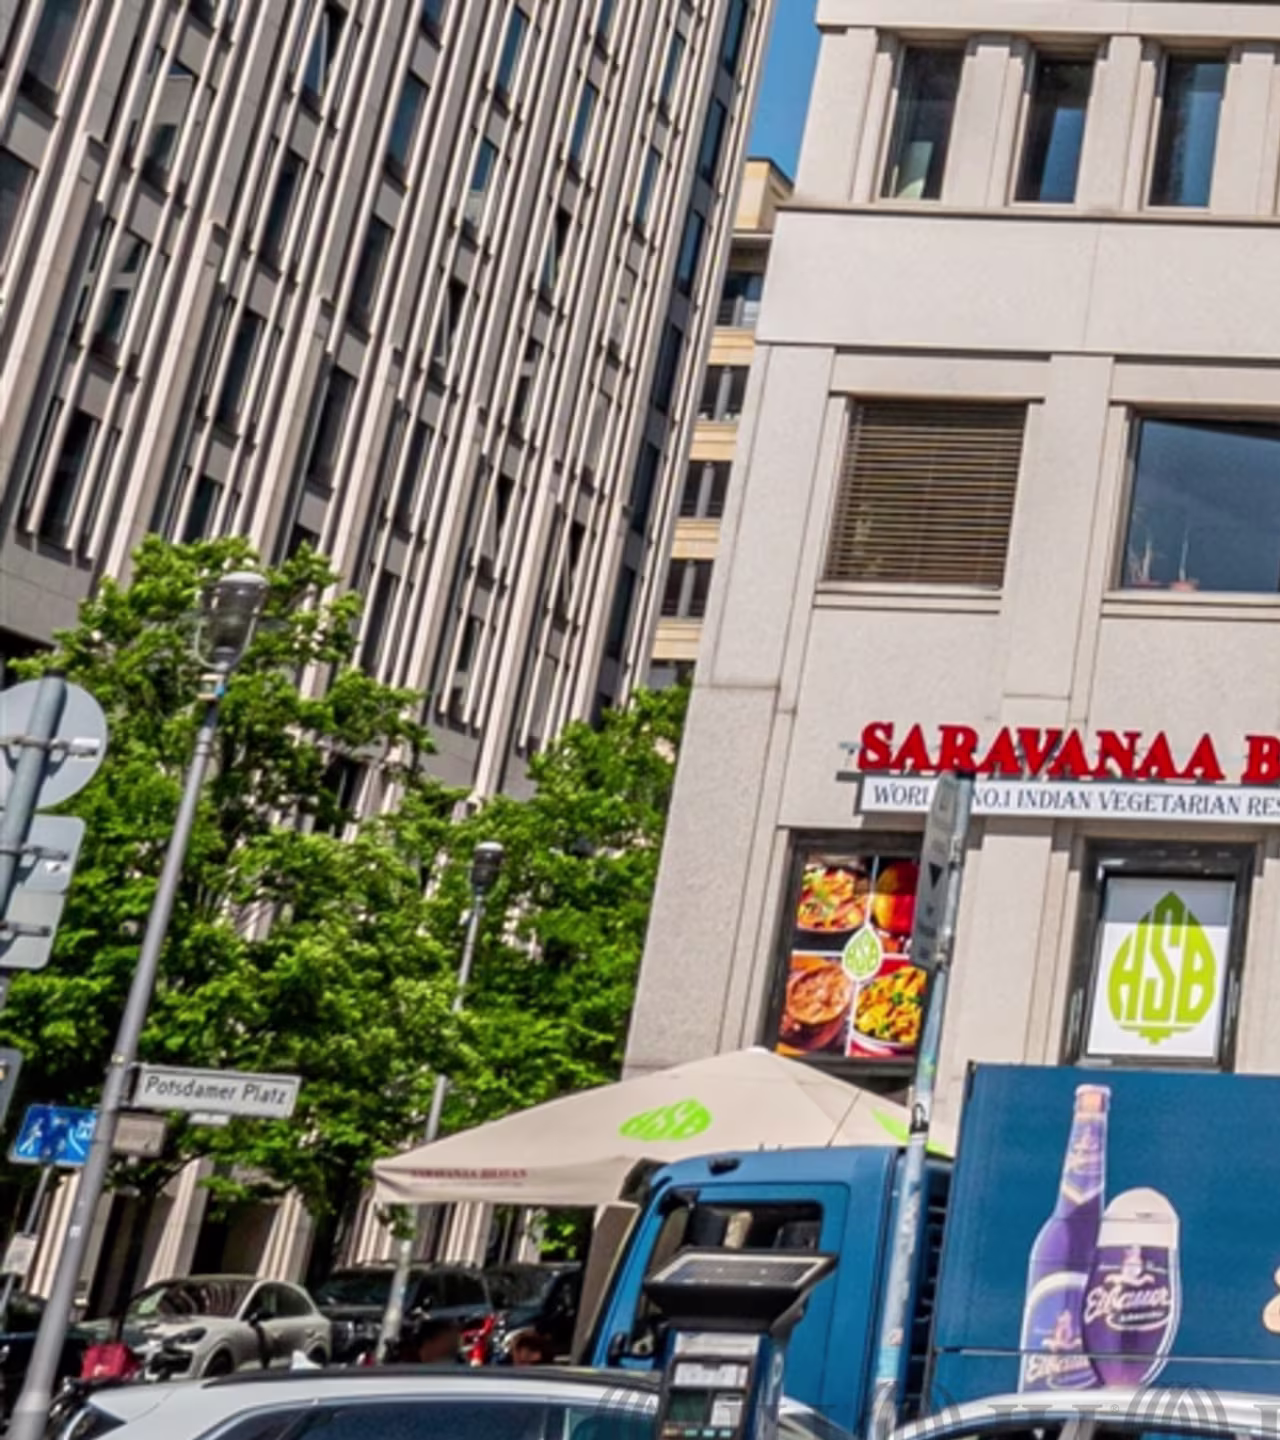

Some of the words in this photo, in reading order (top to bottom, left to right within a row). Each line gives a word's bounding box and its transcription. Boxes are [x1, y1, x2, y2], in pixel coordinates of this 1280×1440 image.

[857, 722, 1225, 783] SARAVANAA
[1016, 788, 1092, 810] INDIAN
[1099, 790, 1241, 815] VEGETARIAN
[144, 1075, 238, 1100] Potsdamer
[242, 1083, 288, 1105] Platz
